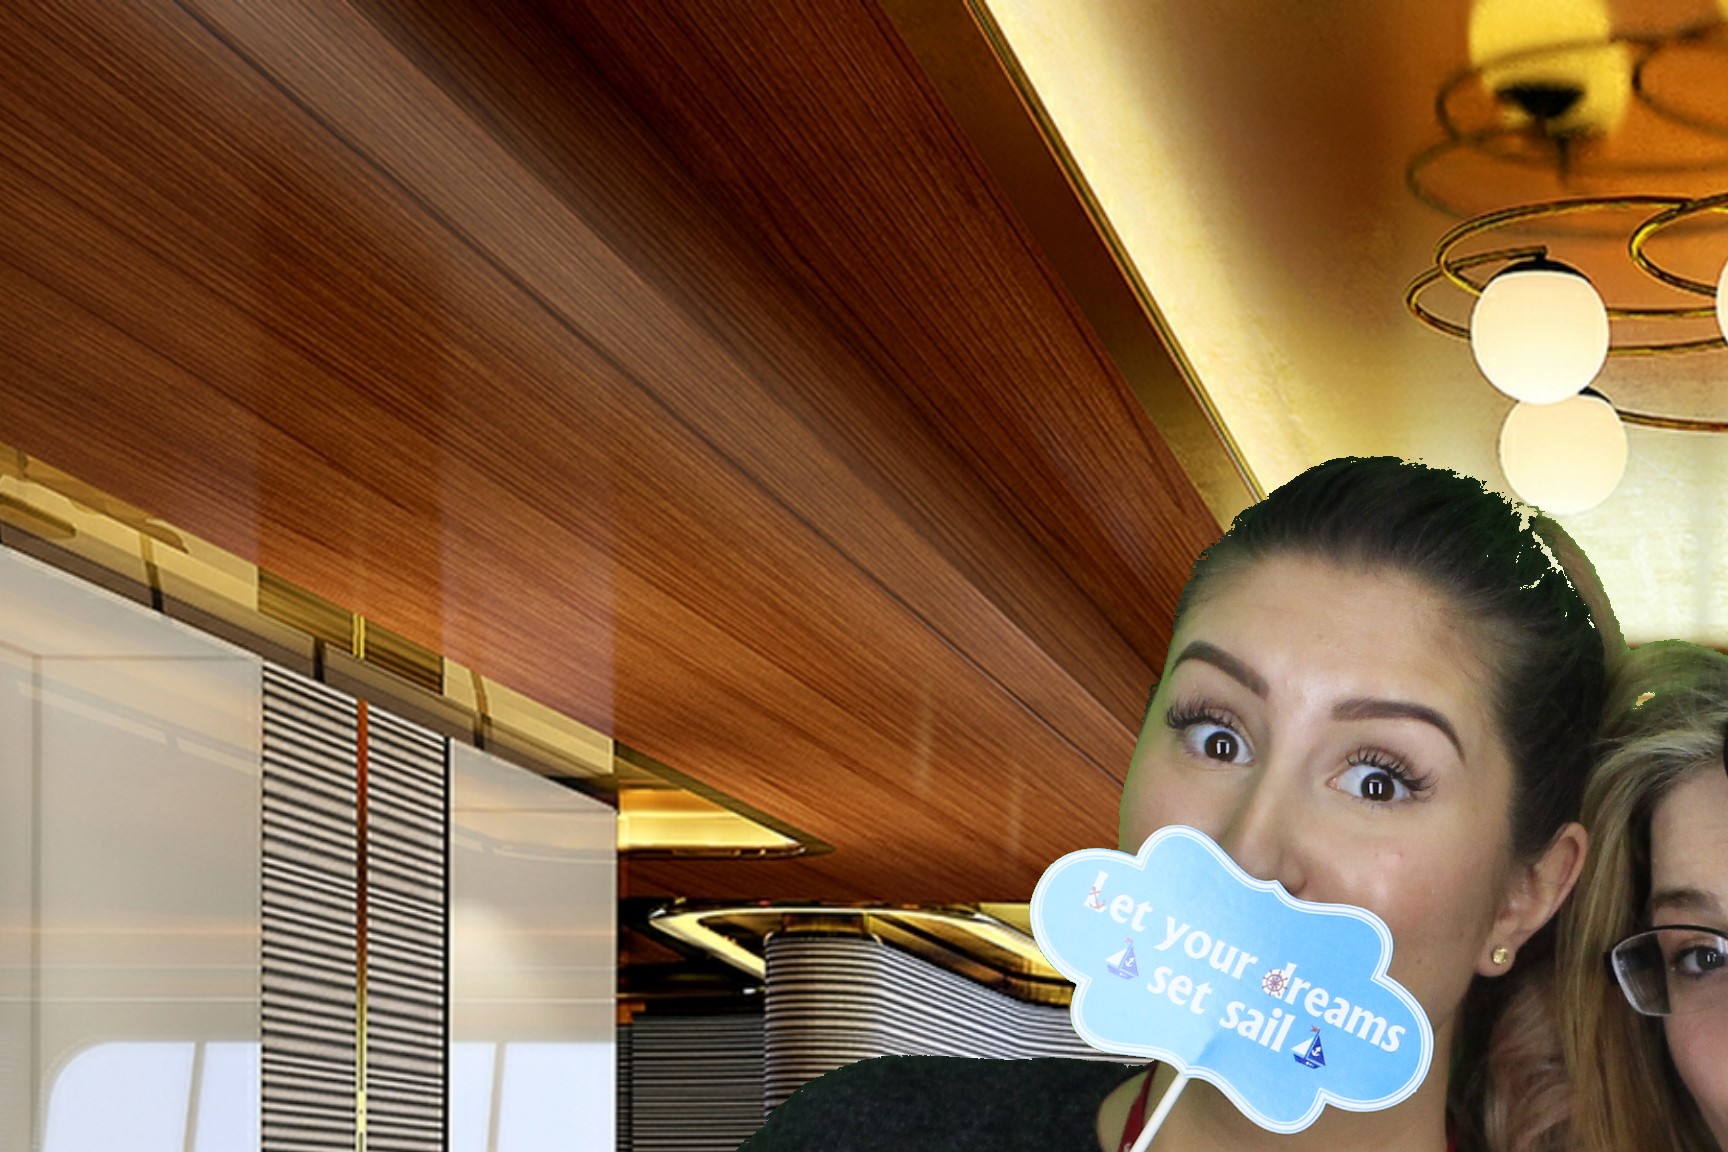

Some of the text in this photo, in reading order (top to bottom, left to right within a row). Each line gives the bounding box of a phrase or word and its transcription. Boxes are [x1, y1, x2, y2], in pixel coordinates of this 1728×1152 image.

[1084, 873, 1406, 1052] Let your dreams
[1147, 967, 1295, 1052] set sail
